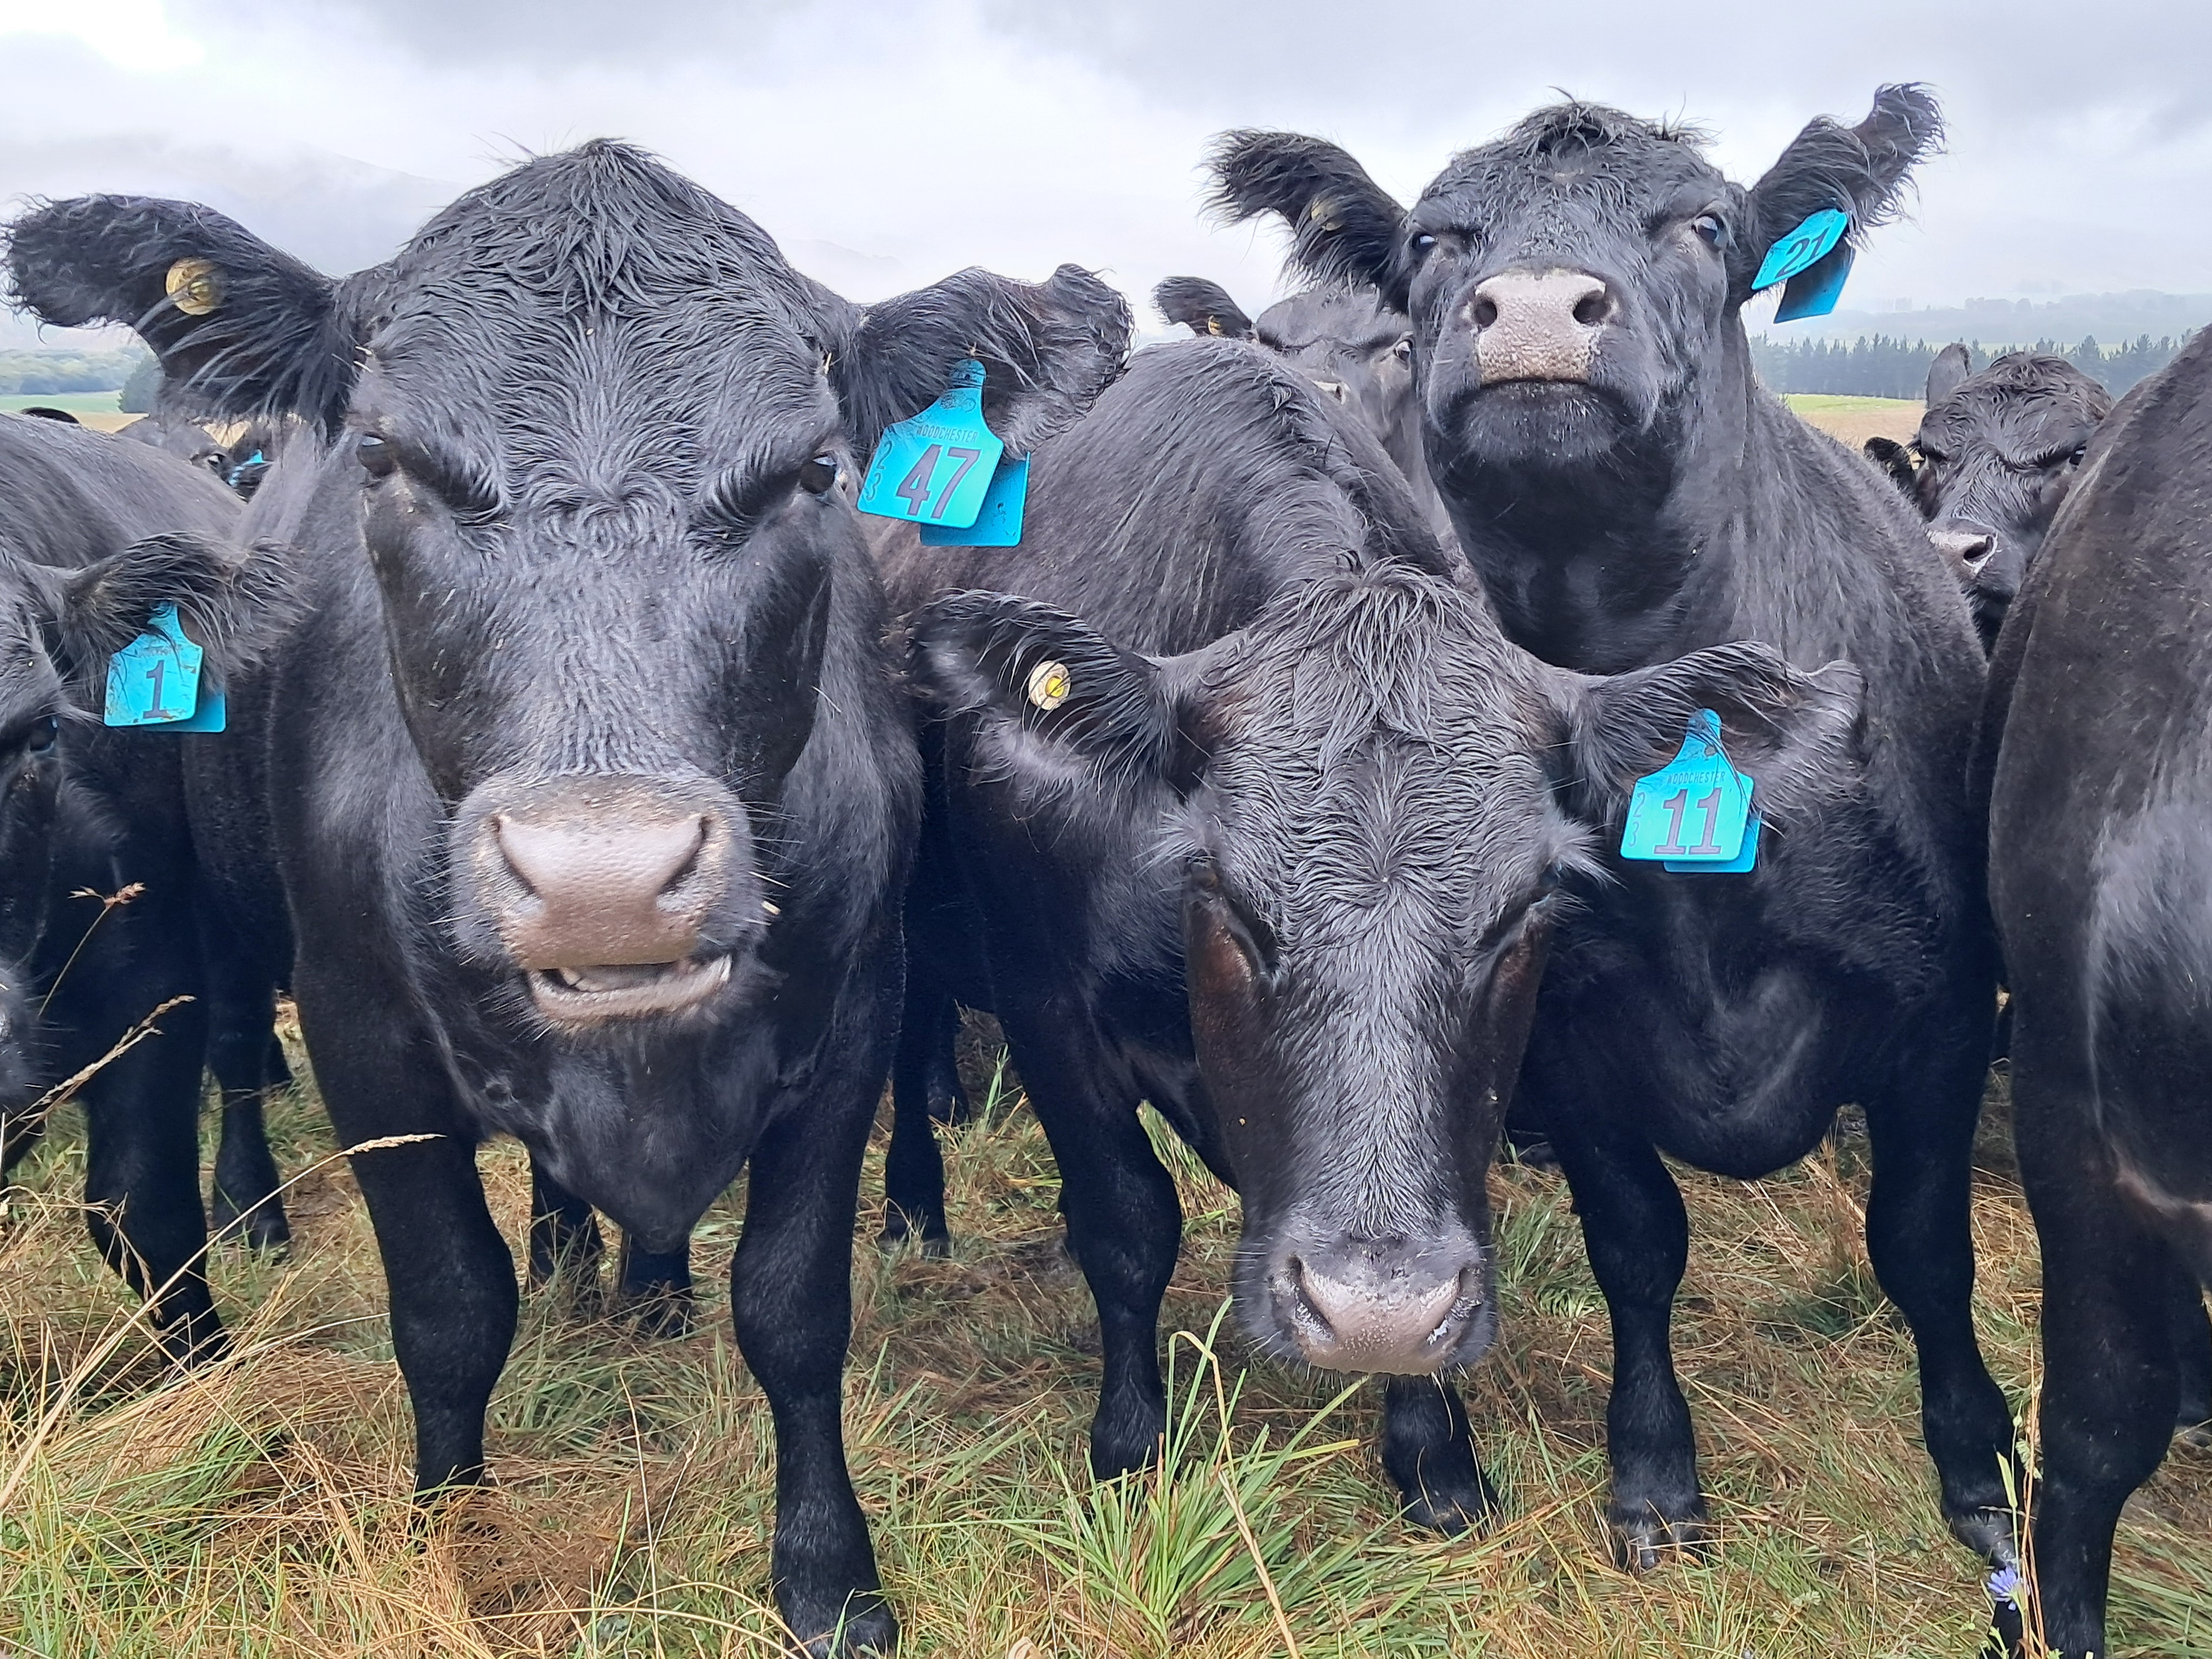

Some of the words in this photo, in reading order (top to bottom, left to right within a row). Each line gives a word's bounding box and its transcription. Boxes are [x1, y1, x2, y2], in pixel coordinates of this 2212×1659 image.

[1774, 226, 1831, 280] 21
[896, 443, 982, 519] 47
[143, 659, 168, 719] 1
[1653, 787, 1722, 855] 11
